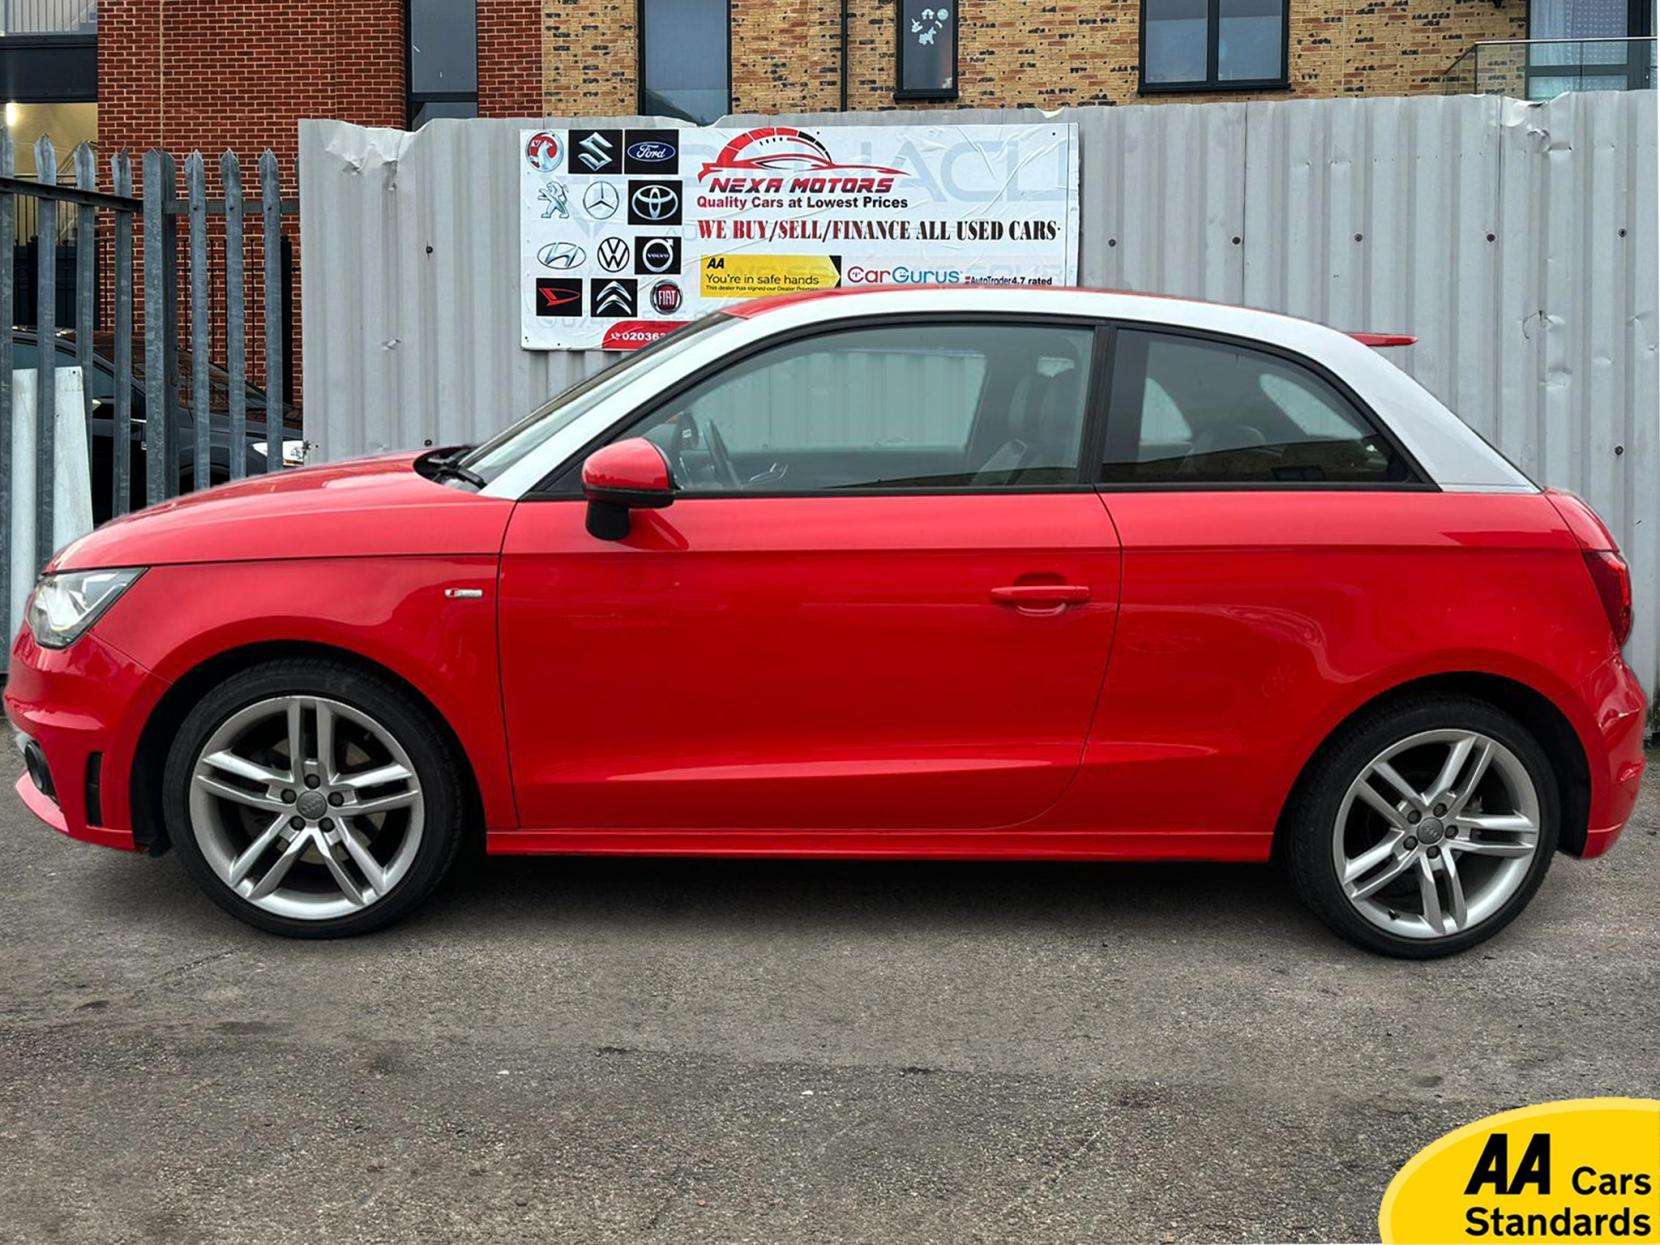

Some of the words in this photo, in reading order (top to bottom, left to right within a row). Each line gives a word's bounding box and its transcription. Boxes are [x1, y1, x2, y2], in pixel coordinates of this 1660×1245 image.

[636, 144, 666, 159] Ford
[709, 178, 783, 193] NEXA
[789, 178, 894, 193] MOTORS
[697, 196, 746, 210] Quality
[752, 196, 784, 208] Cars
[789, 196, 802, 208] at
[807, 196, 858, 208] Lowest
[863, 196, 908, 208] Prices
[697, 219, 727, 240] WE
[732, 219, 911, 242] BUY/SELL/FINANCE
[916, 220, 950, 241] ALL
[956, 220, 1004, 241] USED
[707, 258, 725, 269] AA
[706, 274, 741, 284] You're
[744, 274, 754, 284] in
[757, 274, 781, 285] safe
[784, 275, 819, 285] hands
[847, 266, 960, 283] CarGurus
[1028, 277, 1053, 285] rated
[658, 290, 676, 306] FIAT
